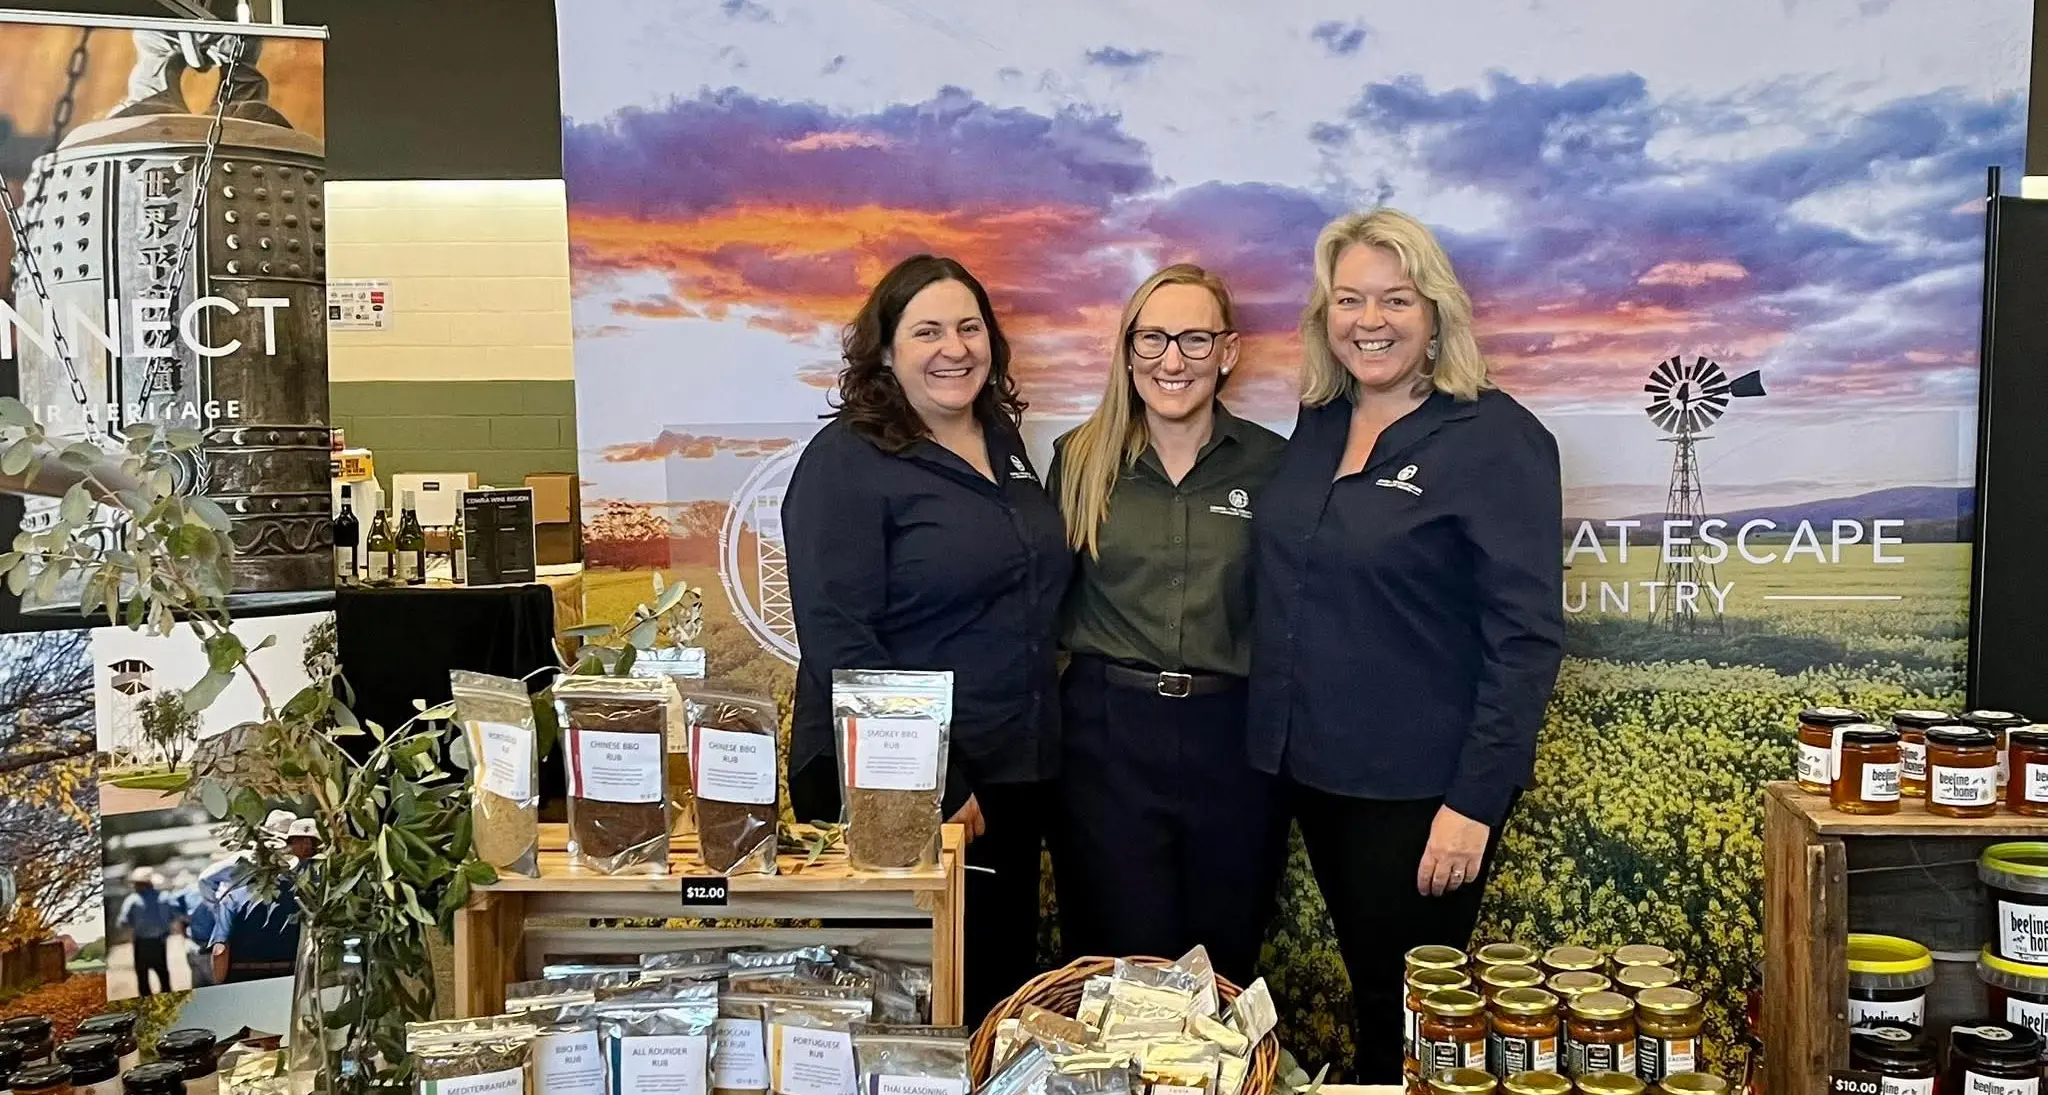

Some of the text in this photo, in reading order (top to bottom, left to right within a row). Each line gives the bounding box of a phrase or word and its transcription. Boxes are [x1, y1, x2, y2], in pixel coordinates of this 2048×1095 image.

[1564, 518, 1906, 565] AT ESCAPE
[1563, 580, 1736, 614] UNTRY
[687, 886, 725, 899] $12.00
[632, 1047, 645, 1056] ALL
[1835, 1079, 1877, 1094] $10.00
